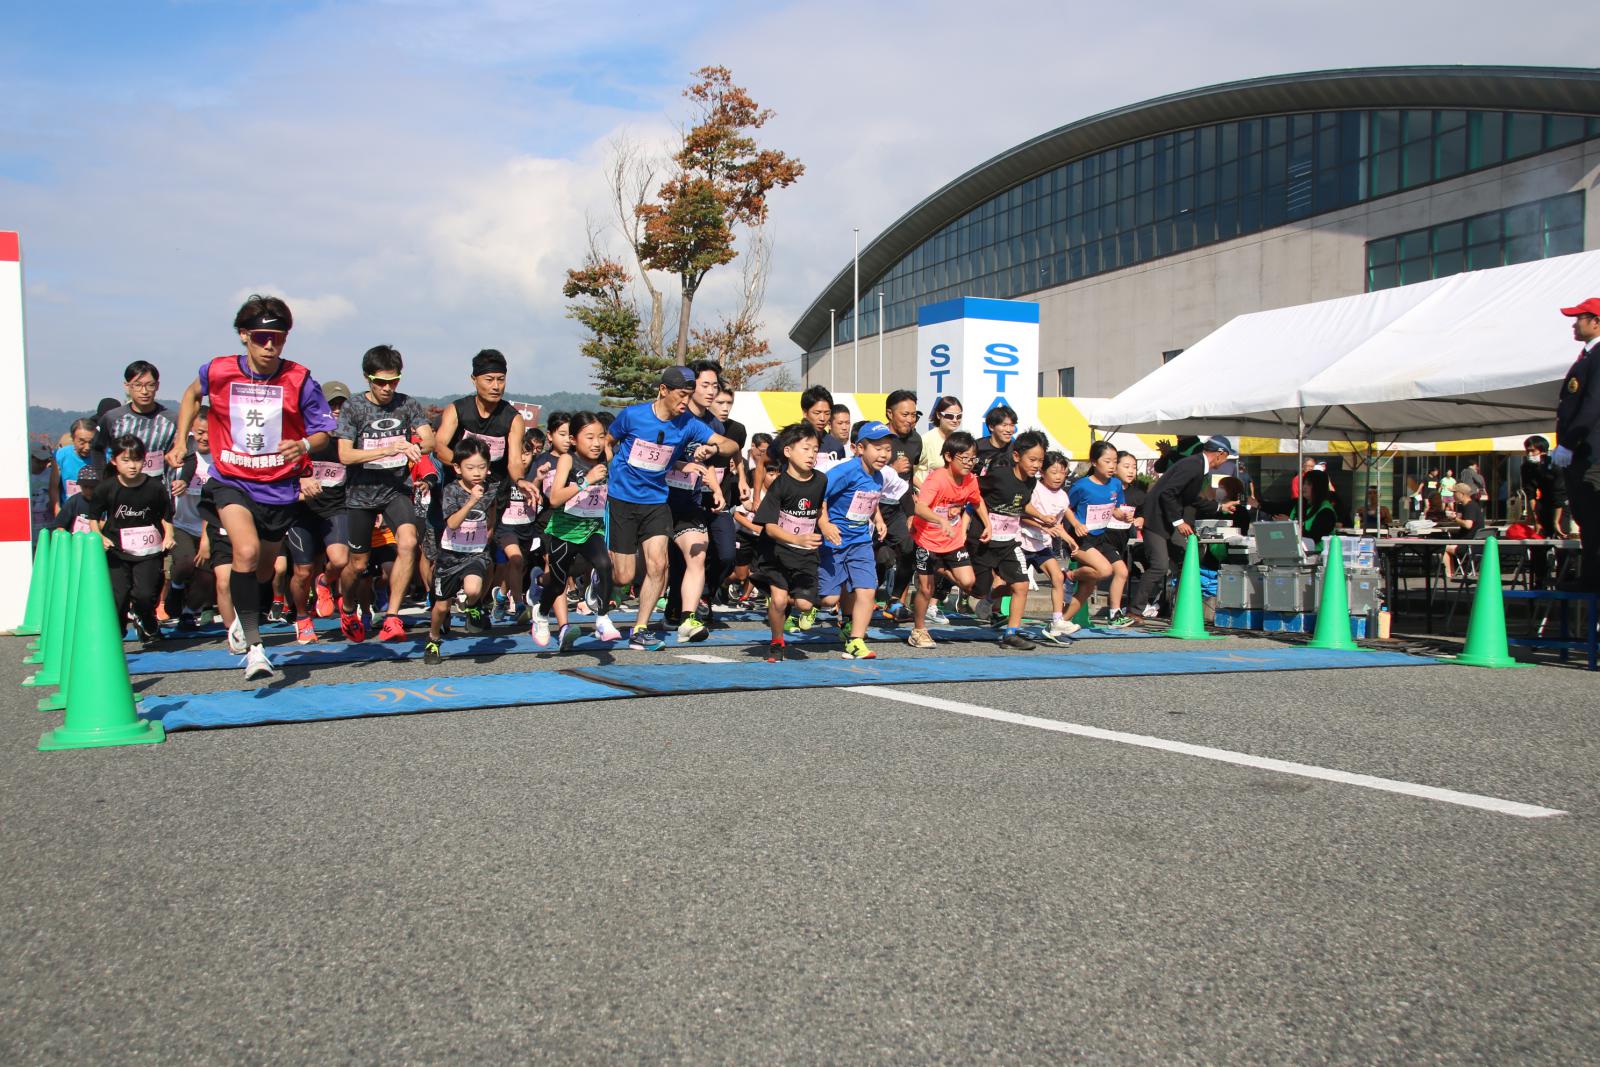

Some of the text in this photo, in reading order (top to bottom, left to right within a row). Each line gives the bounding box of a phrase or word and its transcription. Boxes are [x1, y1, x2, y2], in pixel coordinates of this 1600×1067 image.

[246, 409, 265, 451] 先導
[647, 449, 660, 461] 53
[324, 468, 337, 478] 86
[588, 494, 599, 506] 73
[142, 534, 155, 546] 90
[465, 531, 476, 542] 11
